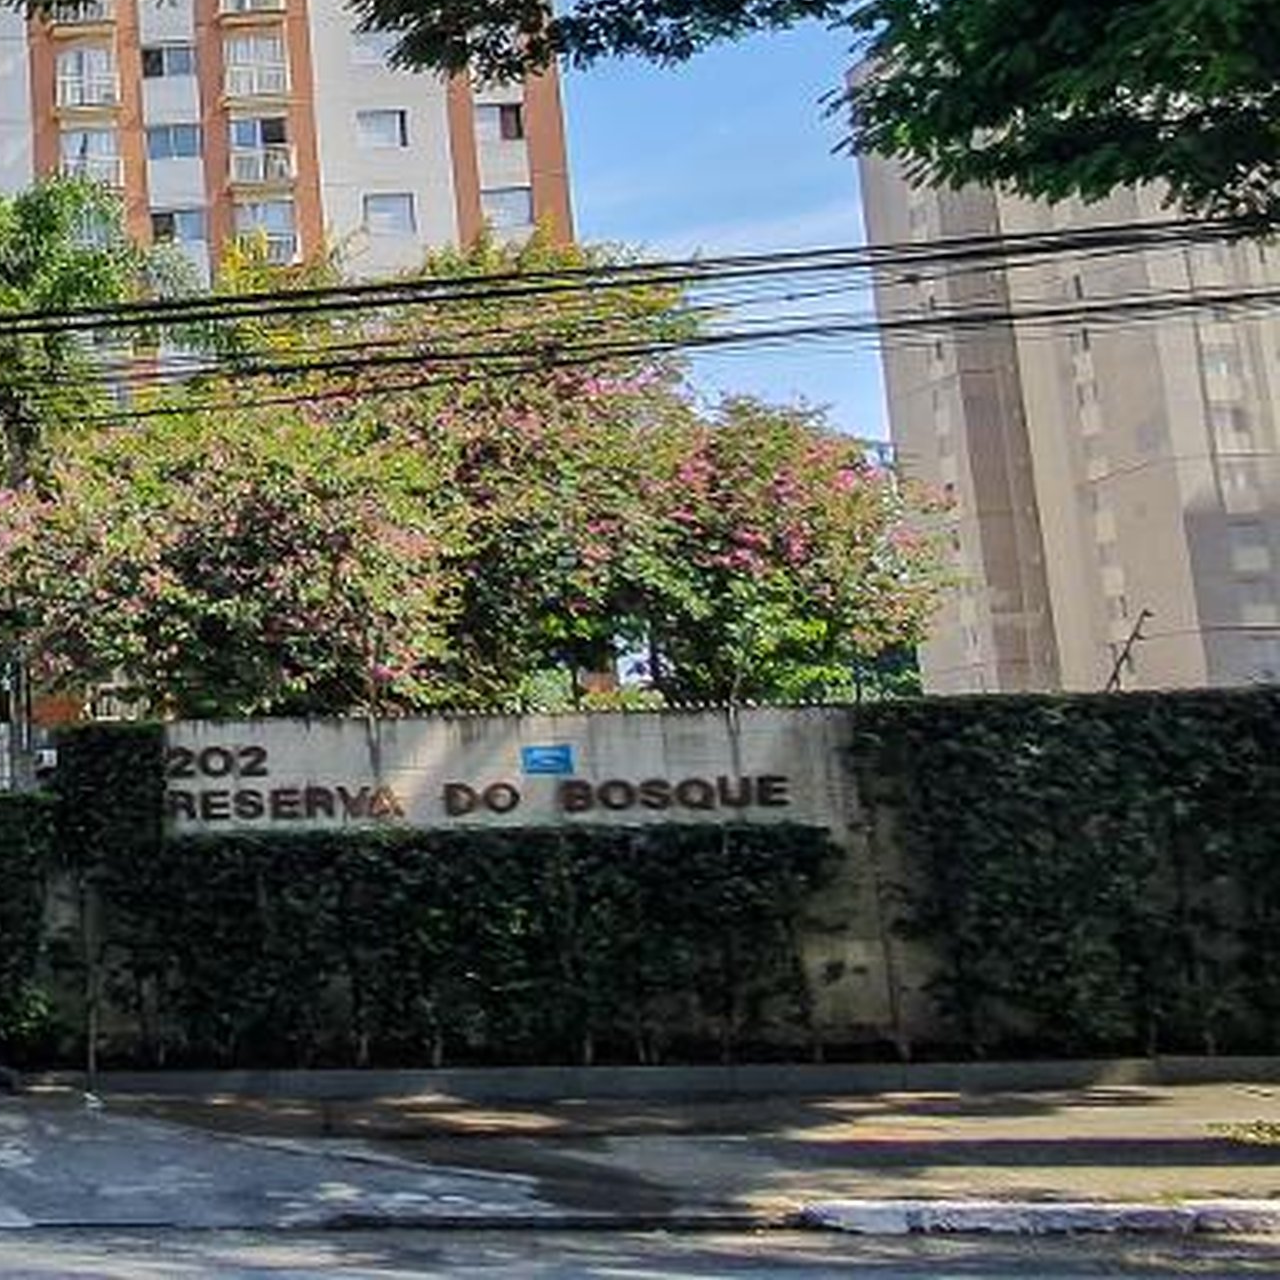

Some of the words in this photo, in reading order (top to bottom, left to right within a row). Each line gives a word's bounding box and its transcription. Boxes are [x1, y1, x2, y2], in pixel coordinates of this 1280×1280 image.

[166, 745, 269, 777] 202
[167, 785, 405, 820] RESERVA
[443, 782, 520, 816] DO
[558, 775, 791, 813] BOSQUE
